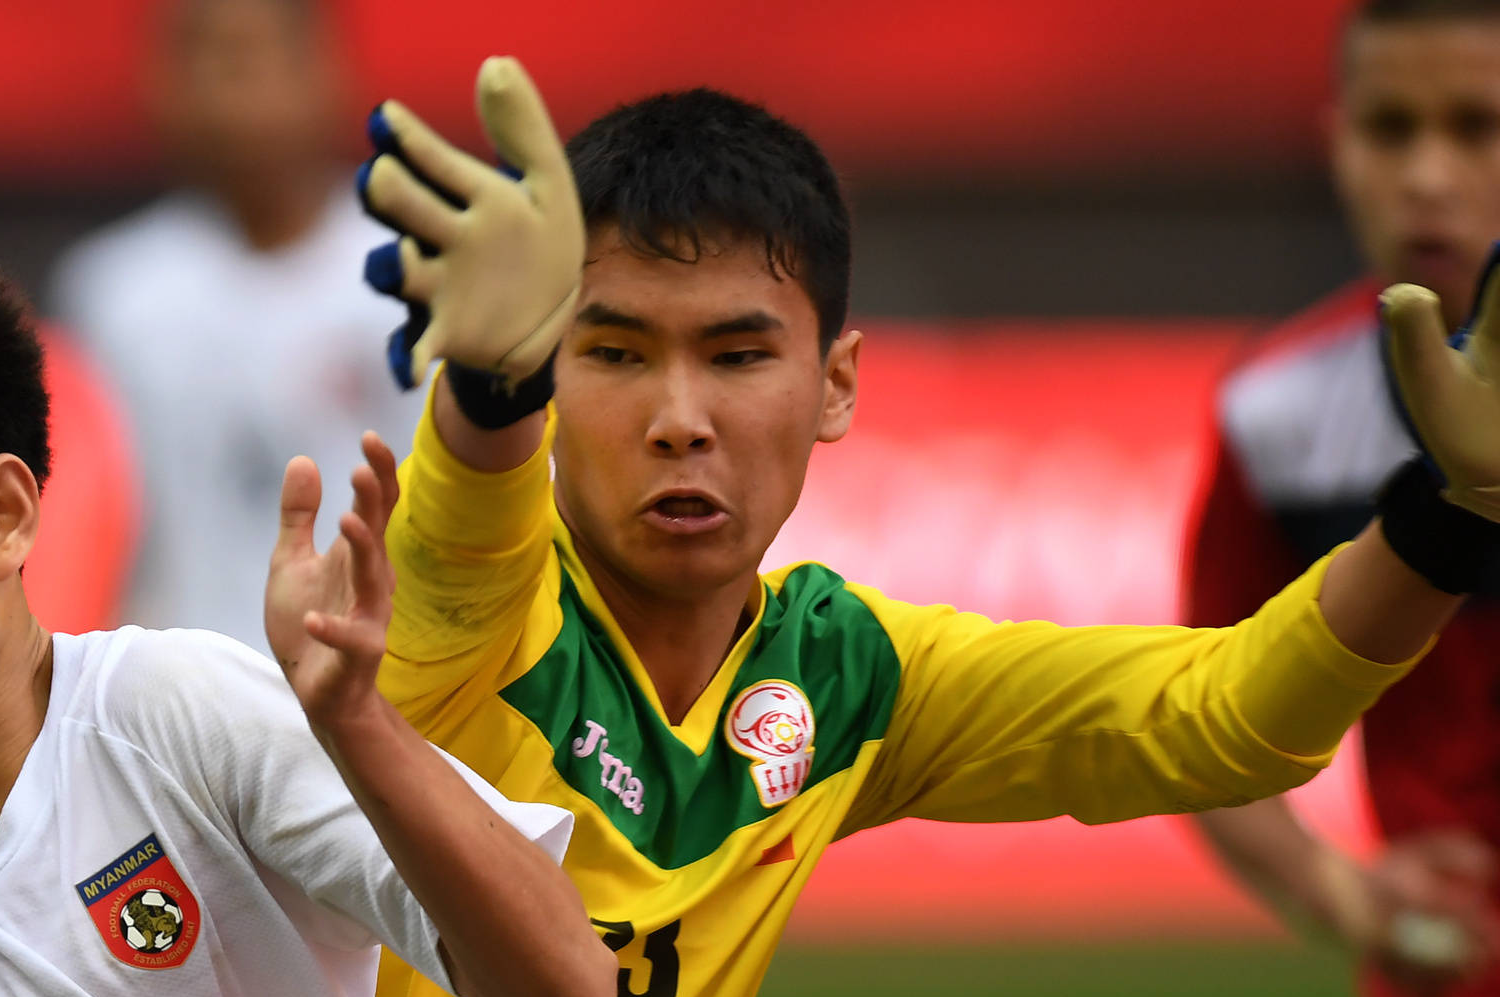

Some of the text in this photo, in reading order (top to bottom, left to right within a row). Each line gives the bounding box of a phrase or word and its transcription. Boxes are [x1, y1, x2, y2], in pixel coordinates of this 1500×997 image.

[573, 720, 645, 815] Jma
[83, 842, 158, 899] MYANMAR
[109, 877, 183, 938] FOOTBALL FEDERATION
[133, 940, 189, 965] ESTABLISHED
